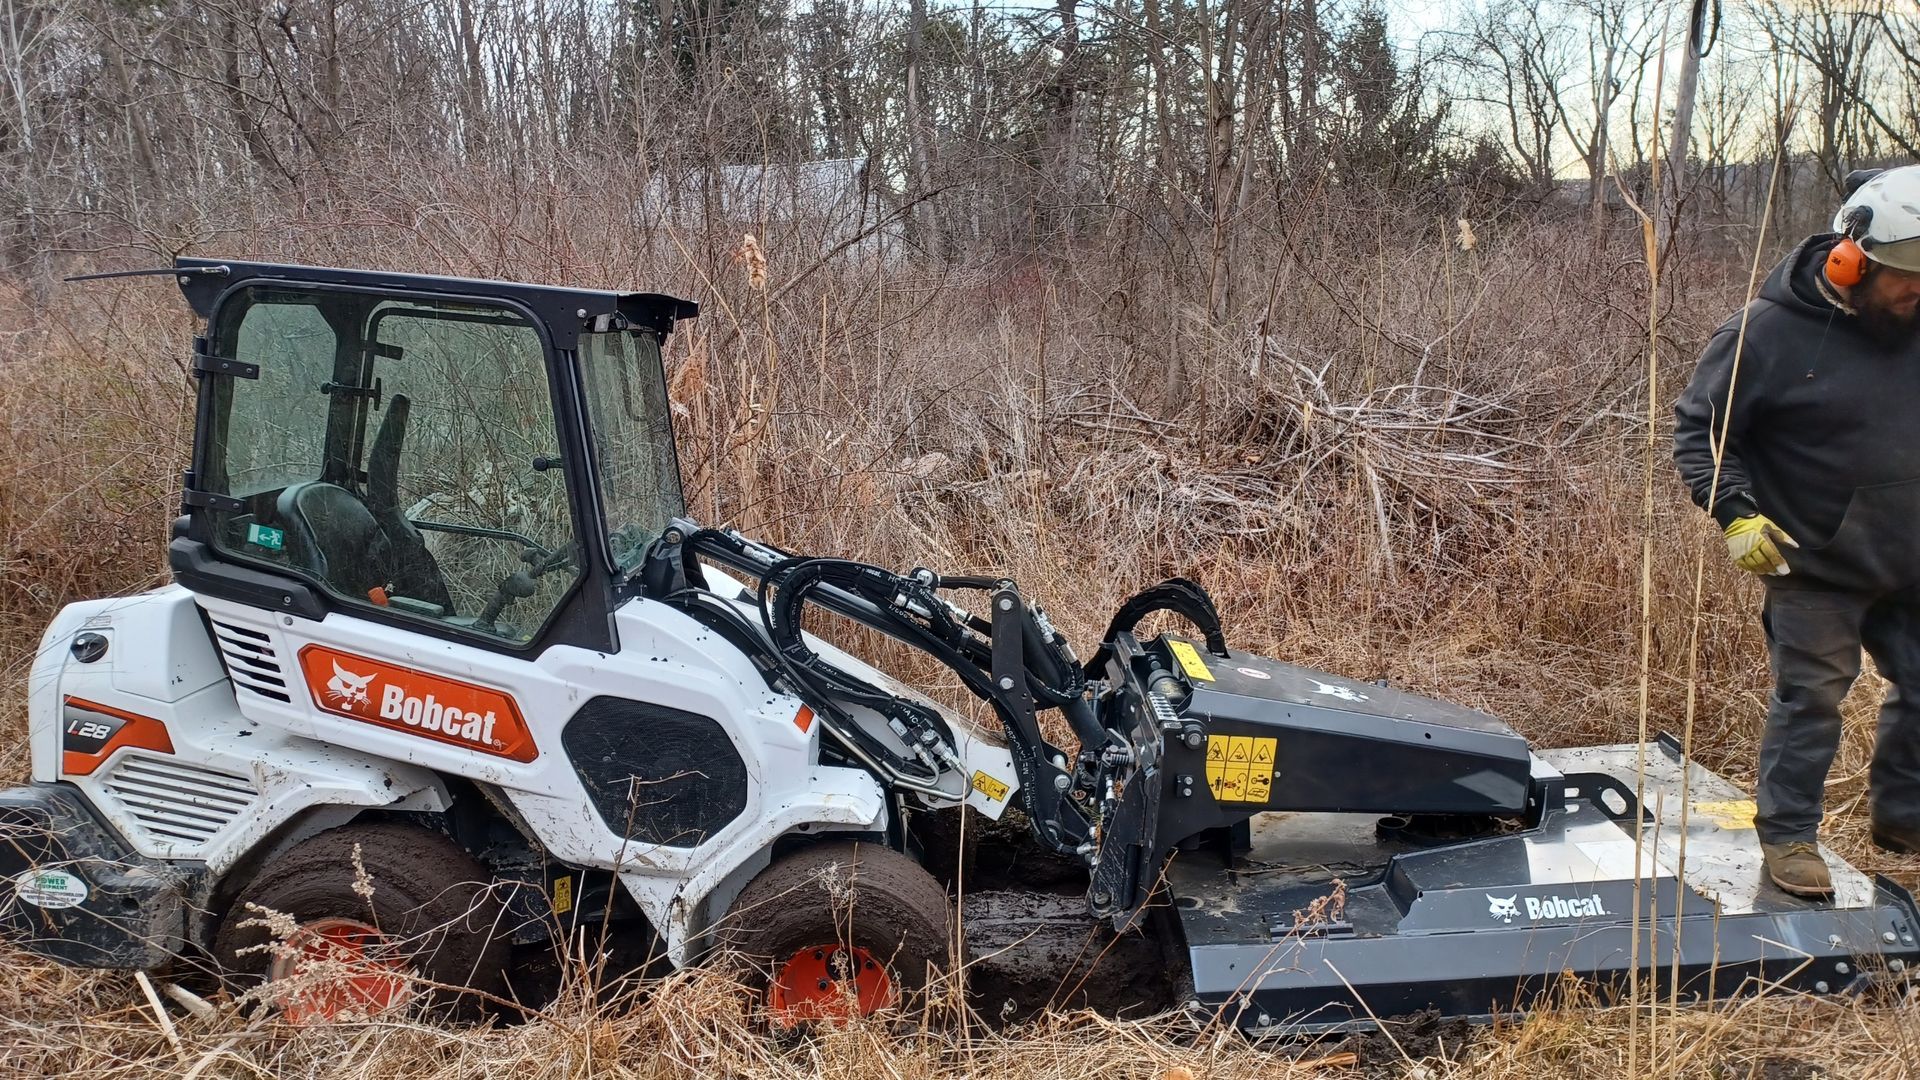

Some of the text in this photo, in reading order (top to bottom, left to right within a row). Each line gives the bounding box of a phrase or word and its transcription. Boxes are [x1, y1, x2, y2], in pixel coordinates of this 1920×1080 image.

[380, 683, 496, 745] Bobcat
[67, 719, 111, 740] L28
[35, 877, 65, 885] POWER
[1524, 894, 1606, 920] Bobcat
